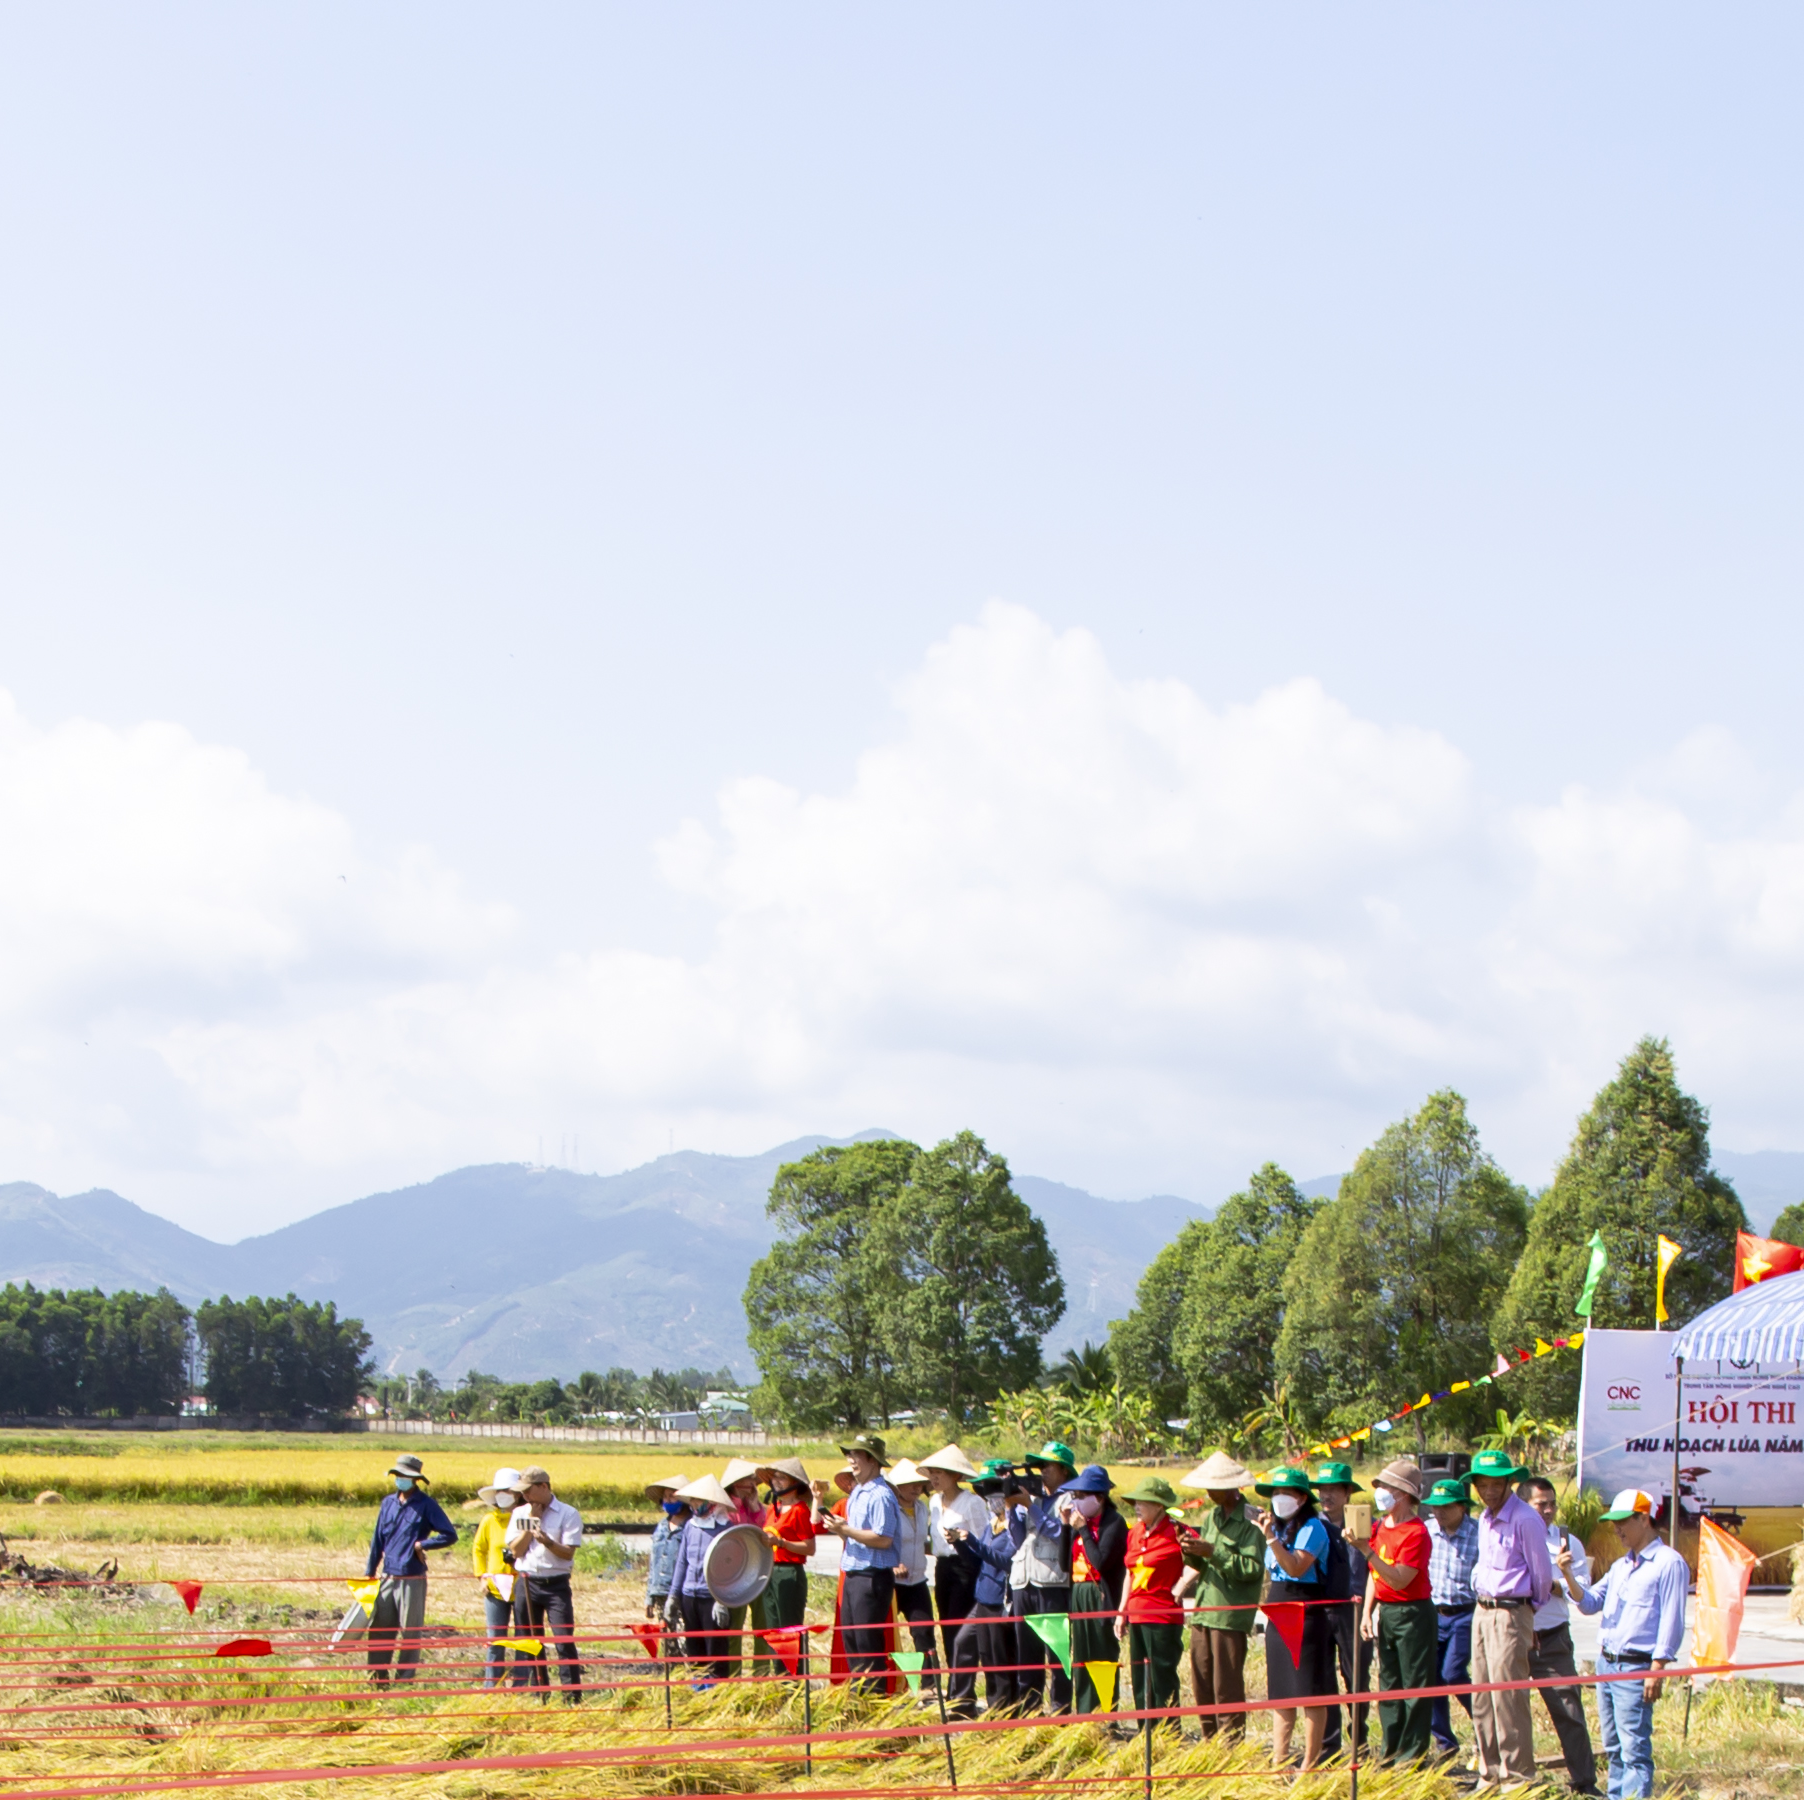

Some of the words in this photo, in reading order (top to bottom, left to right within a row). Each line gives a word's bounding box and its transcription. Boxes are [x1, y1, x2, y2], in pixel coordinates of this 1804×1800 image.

[1607, 1386, 1641, 1400] CNC
[1688, 1394, 1739, 1430] HỘI
[1746, 1401, 1796, 1424] THI
[1625, 1438, 1660, 1452] THU
[1663, 1438, 1725, 1457] HOẠCH
[1728, 1434, 1760, 1452] LÚA
[1765, 1434, 1804, 1452] NĂM
